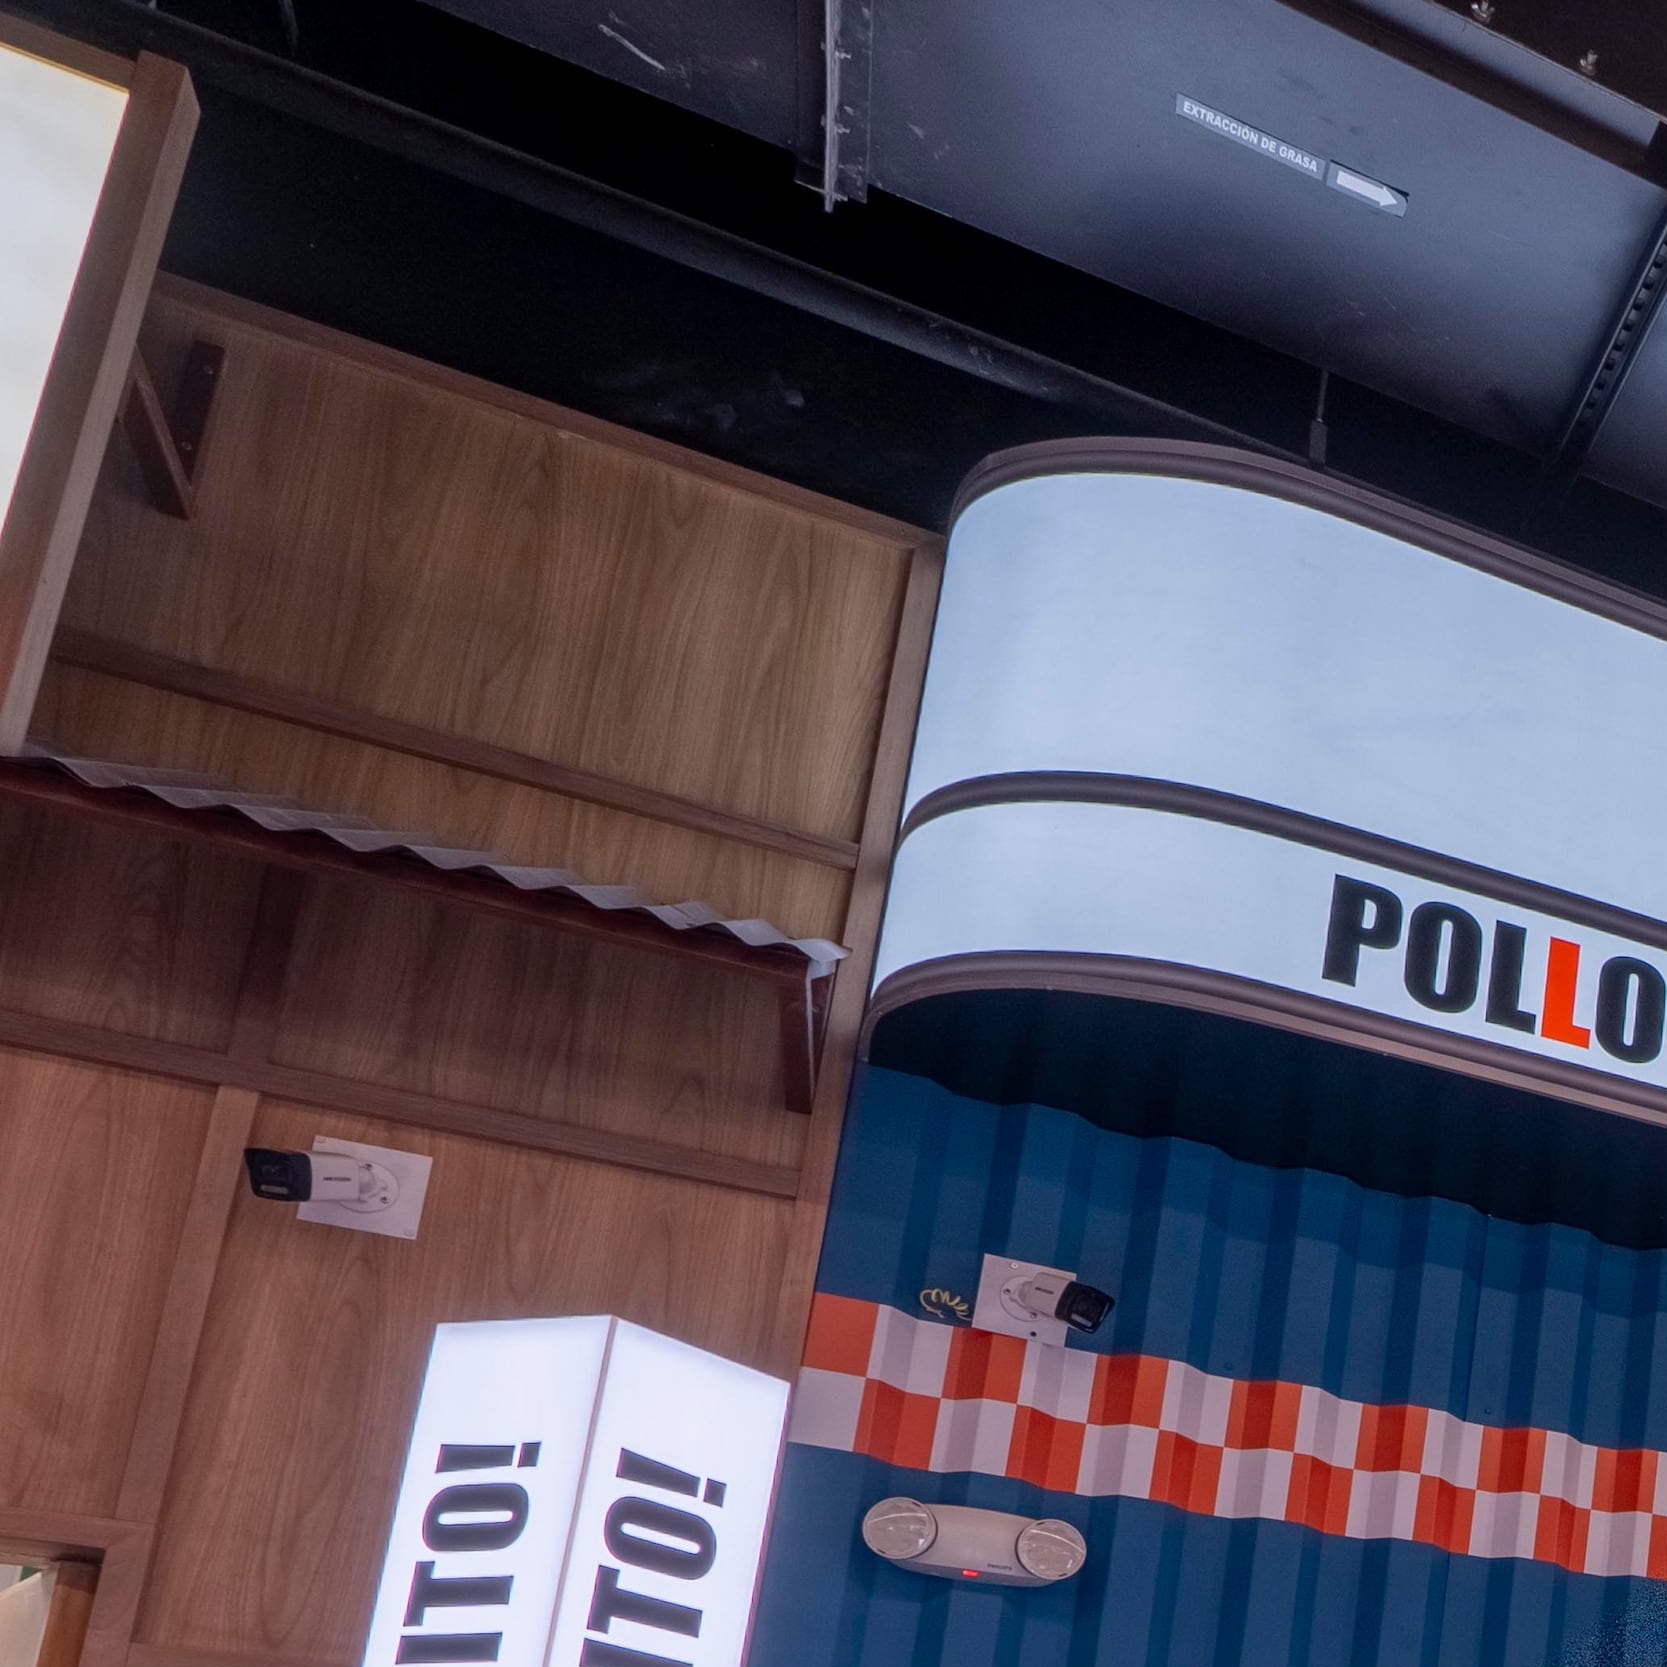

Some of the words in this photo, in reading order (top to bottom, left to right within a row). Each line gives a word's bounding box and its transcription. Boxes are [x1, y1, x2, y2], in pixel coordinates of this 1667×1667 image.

[1183, 100, 1259, 145] EXTRACCIÓN
[1260, 137, 1276, 153] DE
[1279, 146, 1318, 173] GRASA
[1321, 873, 1667, 1065] POLLO
